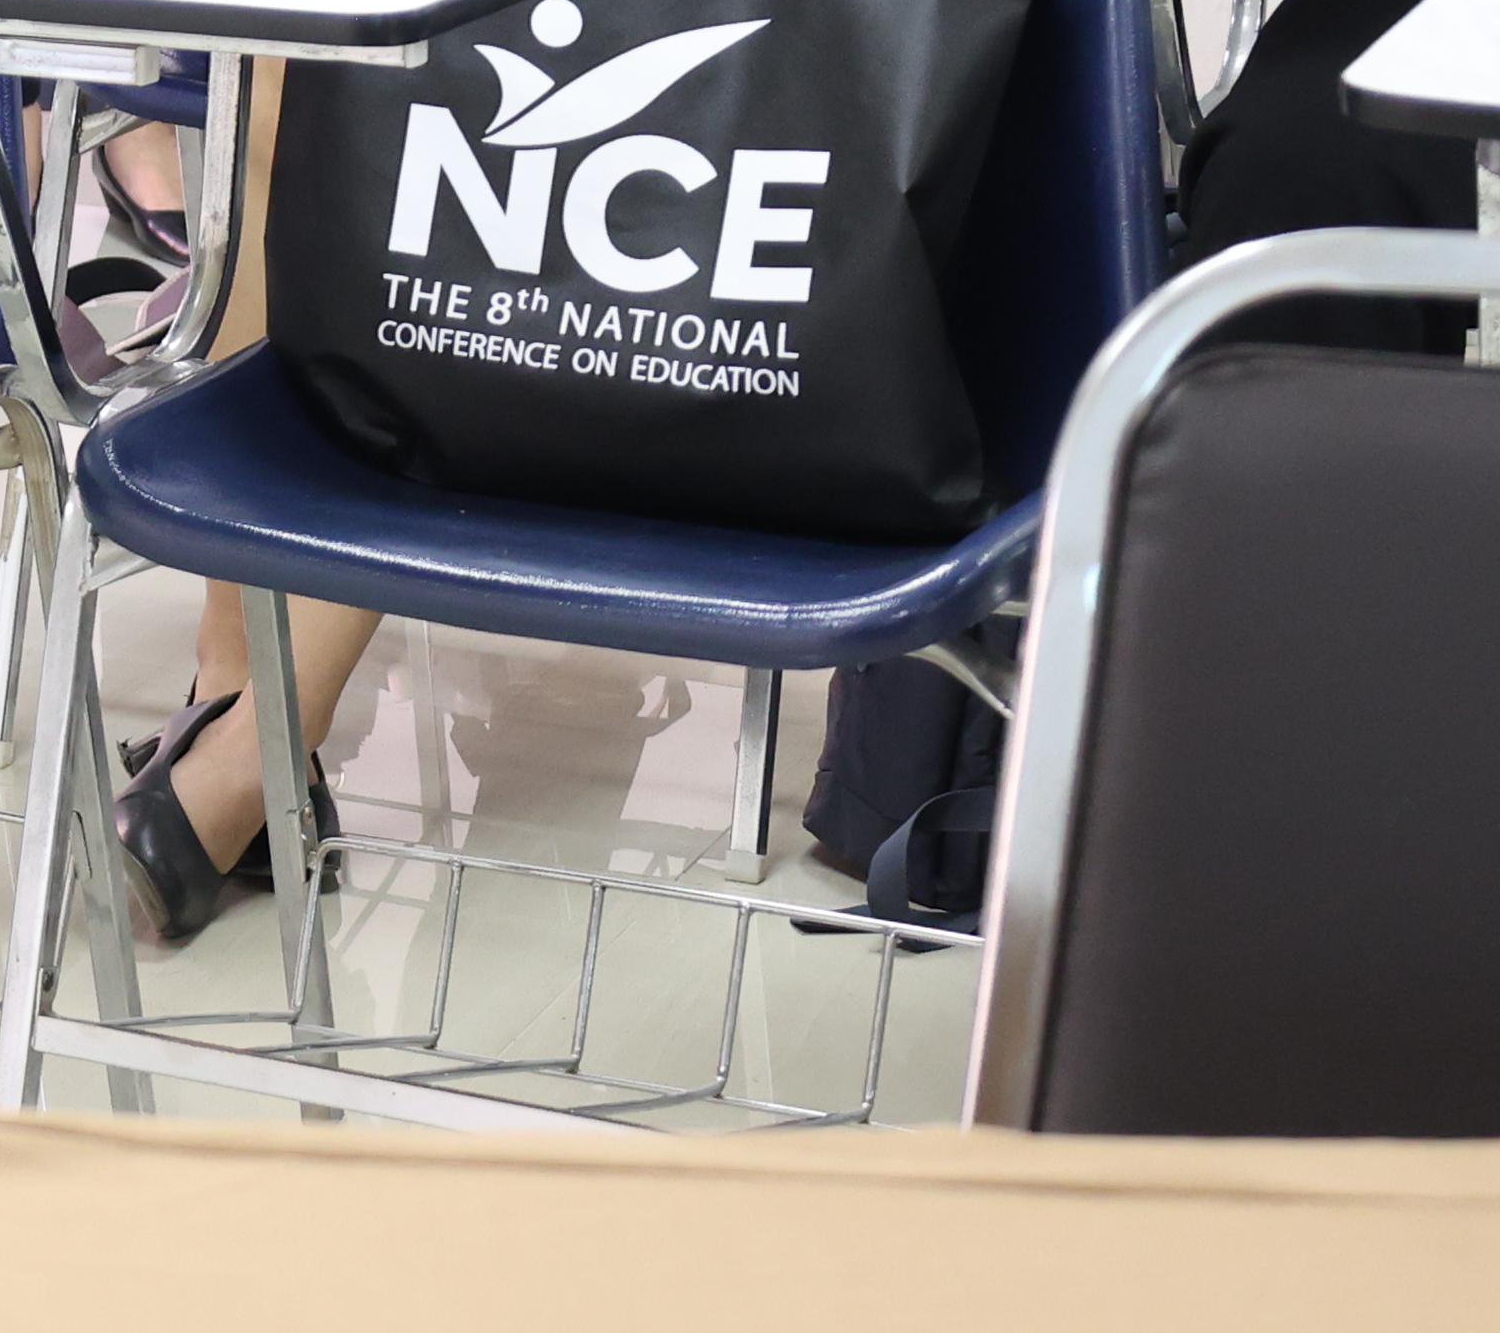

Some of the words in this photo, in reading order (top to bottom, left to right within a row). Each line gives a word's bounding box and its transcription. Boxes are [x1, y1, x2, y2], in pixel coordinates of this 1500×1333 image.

[388, 102, 831, 304] NCE
[377, 320, 561, 370] CONFERENCE
[571, 347, 619, 377] ON
[630, 354, 800, 397] EDUCATION
[382, 273, 472, 321] THE
[486, 286, 550, 326] 8th
[558, 300, 800, 360] NATIONAL
